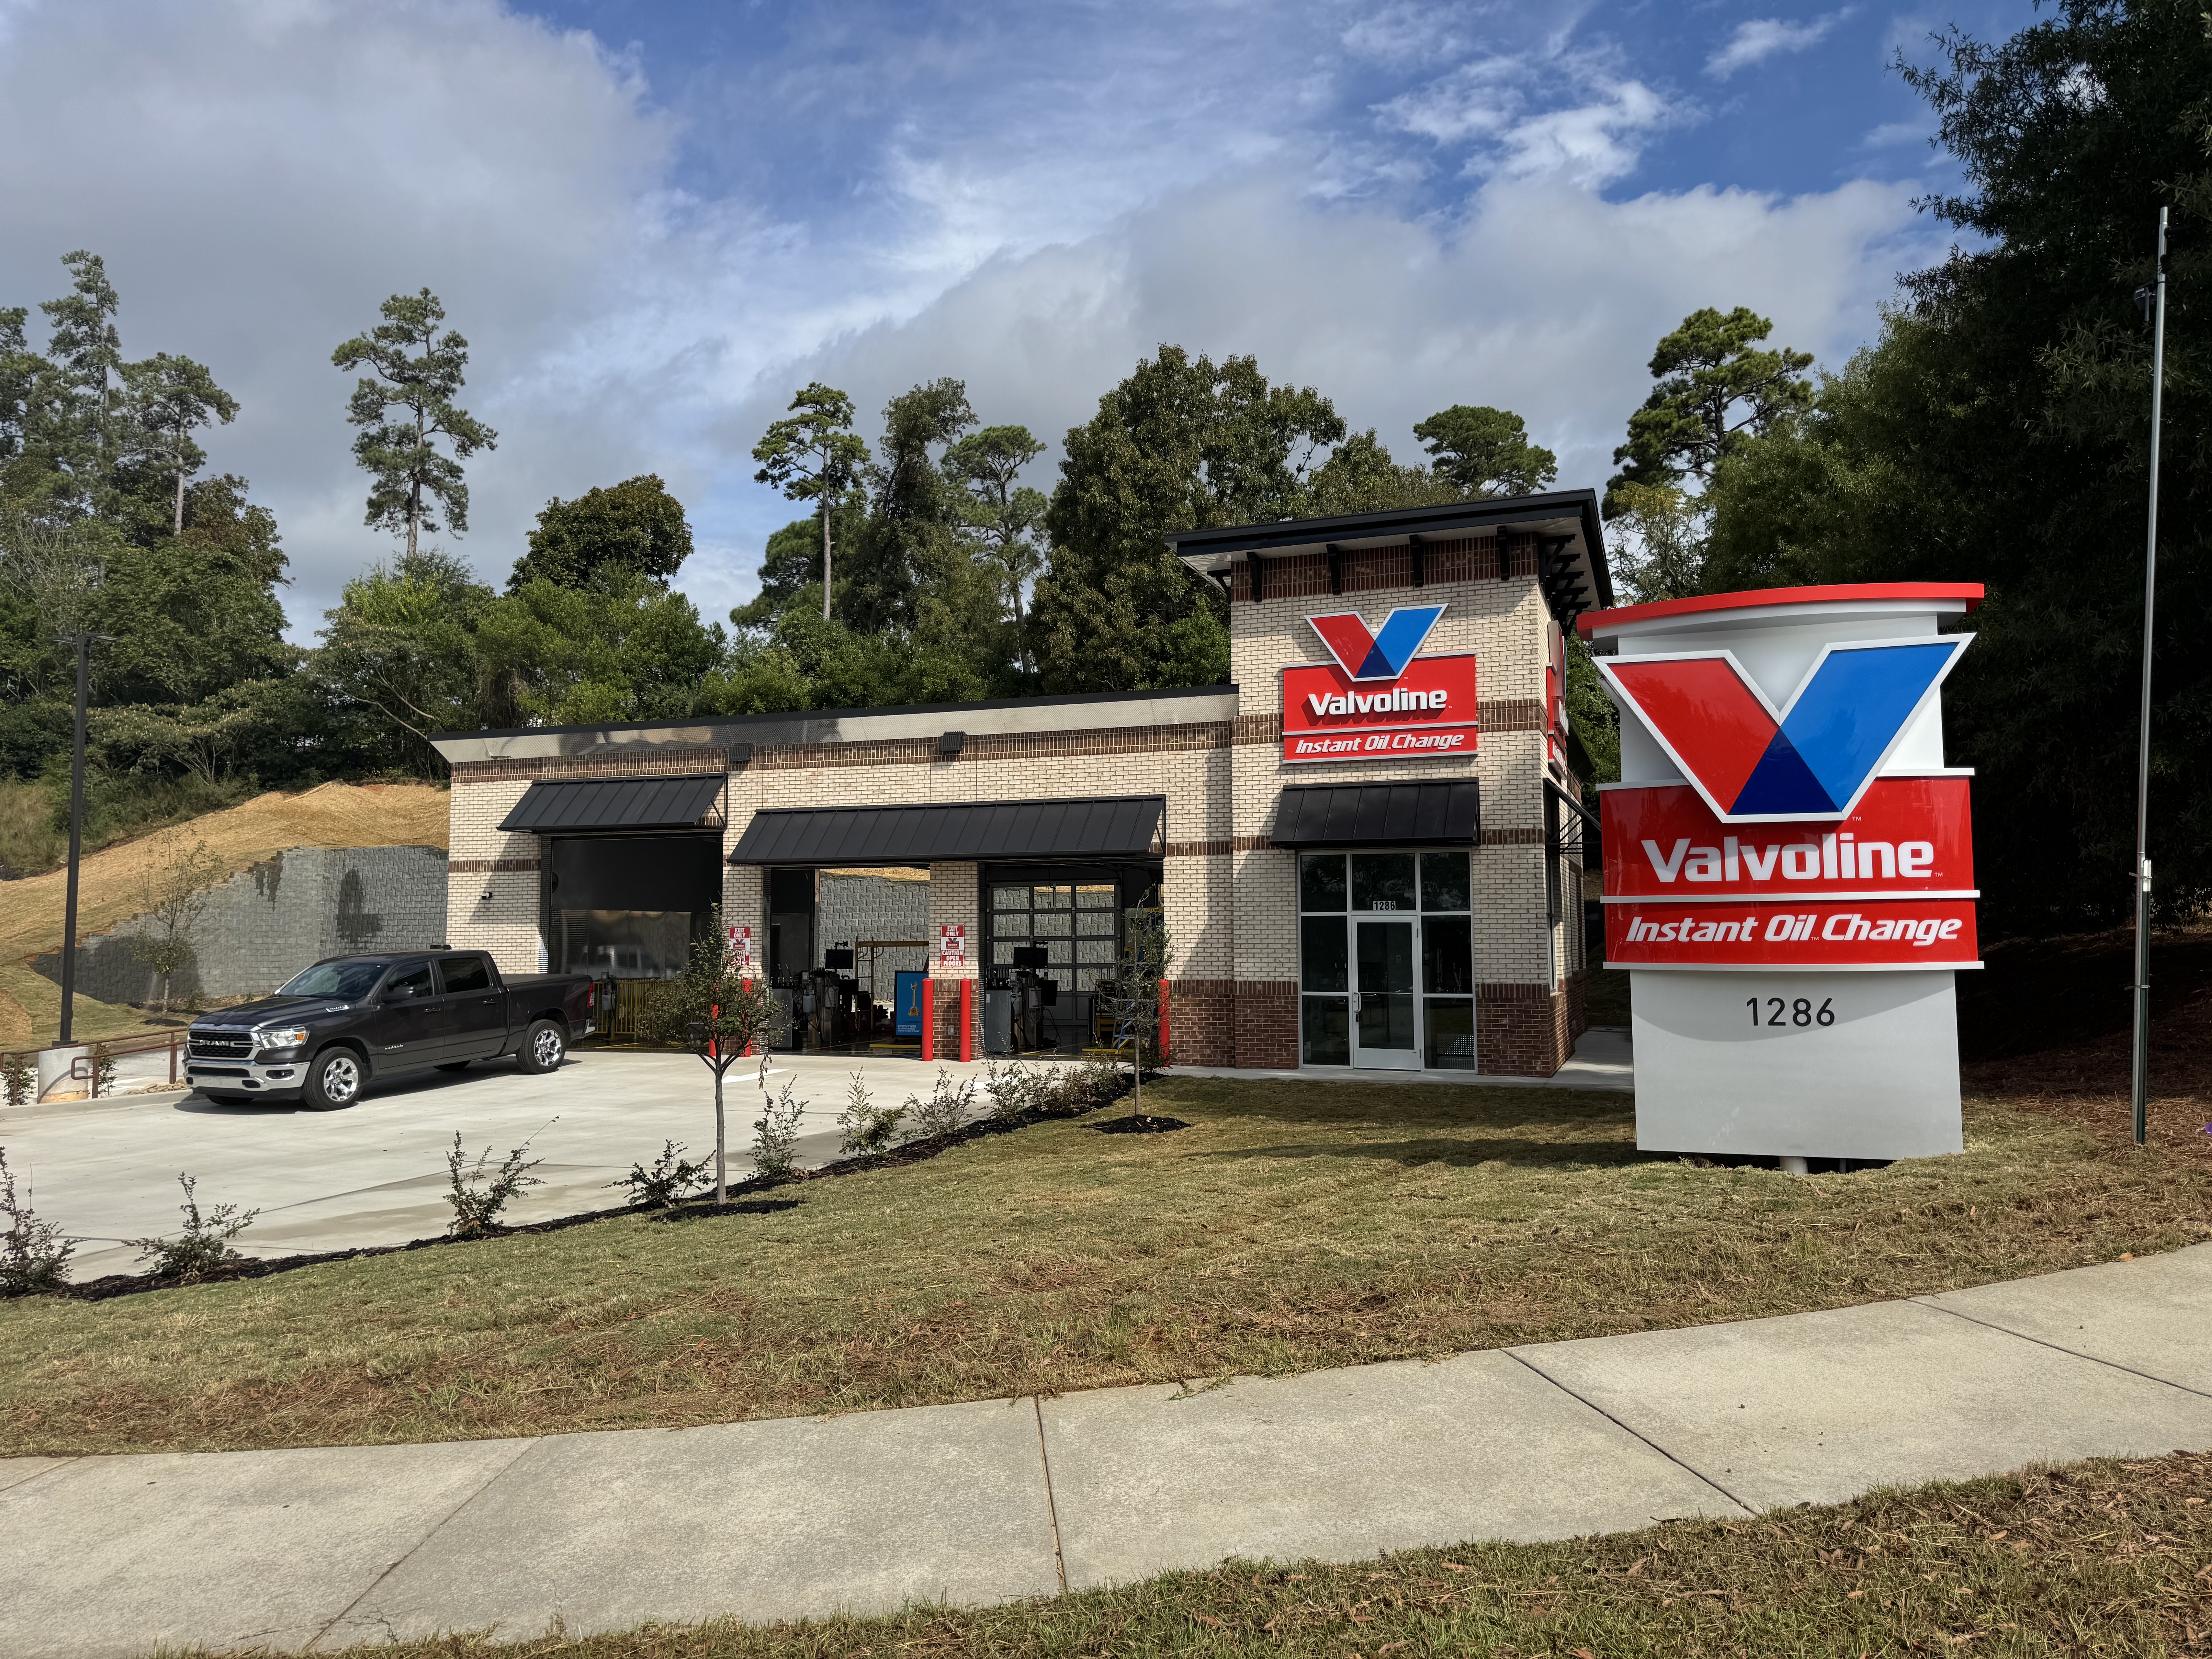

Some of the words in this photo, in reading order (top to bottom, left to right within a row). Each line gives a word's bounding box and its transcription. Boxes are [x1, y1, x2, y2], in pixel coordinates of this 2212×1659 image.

[1308, 687, 1447, 716] Valvoline
[1295, 738, 1362, 754] Instant
[1364, 735, 1391, 750] Oil
[1392, 734, 1465, 750] Change
[1641, 833, 1934, 883] Valvoline
[1374, 901, 1395, 910] 1286
[1626, 917, 1759, 942] Instant
[1764, 914, 1817, 941] Oil
[1822, 914, 1962, 946] Change
[1747, 997, 1835, 1027] 1286
